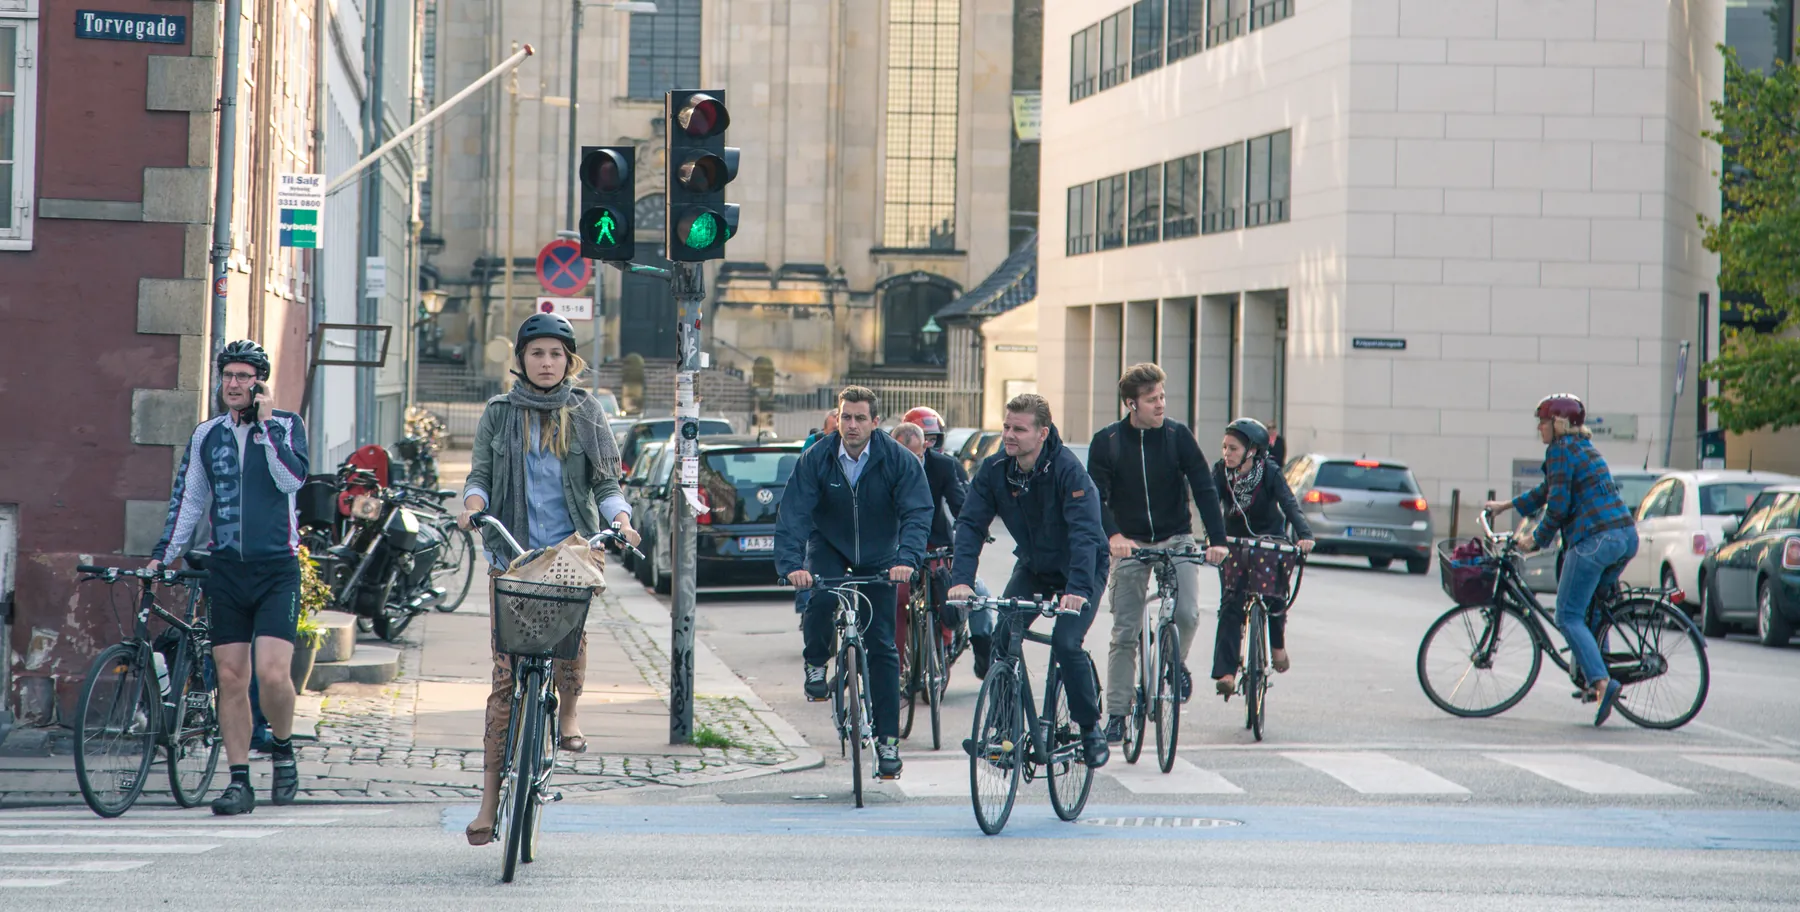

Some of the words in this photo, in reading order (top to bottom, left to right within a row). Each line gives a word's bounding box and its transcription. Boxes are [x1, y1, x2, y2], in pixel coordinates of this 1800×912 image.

[83, 12, 177, 40] Torvegade
[282, 175, 294, 184] Til
[296, 176, 319, 187] Salg
[278, 198, 298, 206] 3311
[300, 199, 321, 207] 0800
[279, 223, 318, 232] Nybolig
[561, 305, 585, 313] 15-18
[747, 537, 760, 548] AA
